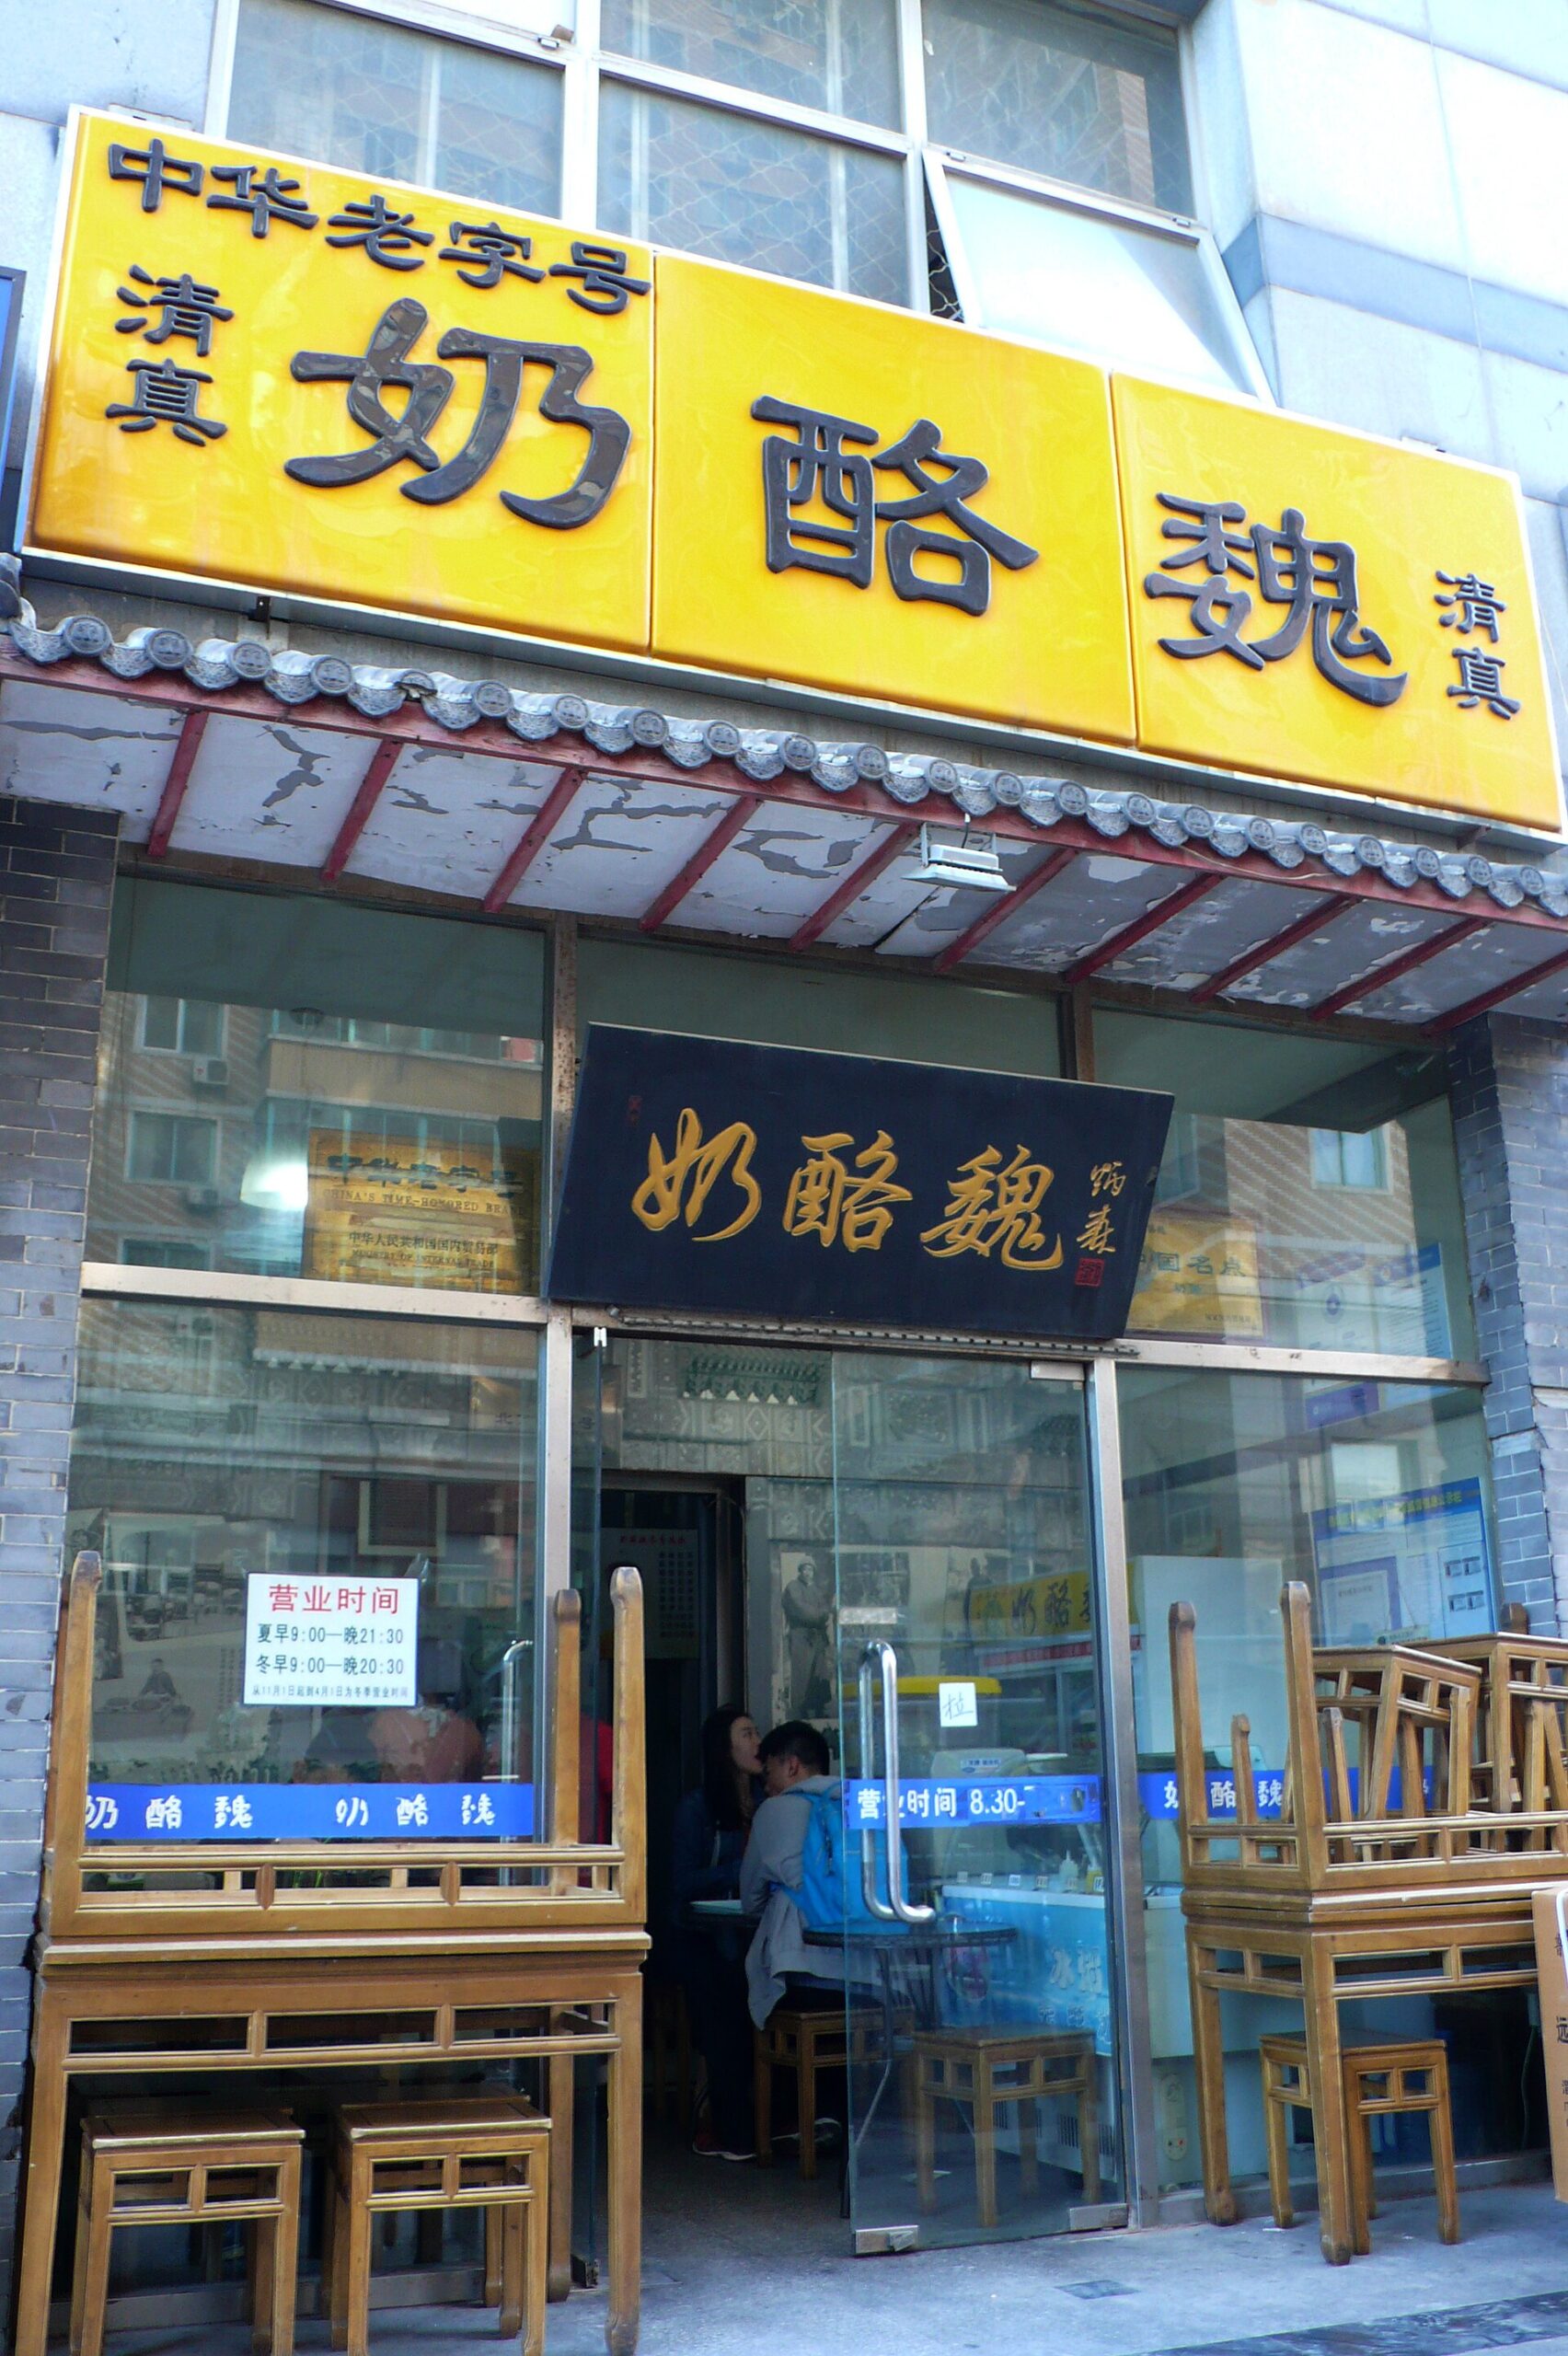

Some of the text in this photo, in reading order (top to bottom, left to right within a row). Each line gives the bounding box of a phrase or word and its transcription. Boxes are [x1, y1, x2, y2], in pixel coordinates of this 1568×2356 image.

[108, 138, 651, 315] 中华老字号
[105, 264, 234, 446] 清真
[283, 297, 1408, 708] 奶酪魏
[1435, 570, 1520, 720] 清真
[631, 1107, 1063, 1271] 奶酪魏
[269, 1584, 399, 1614] 营业时间
